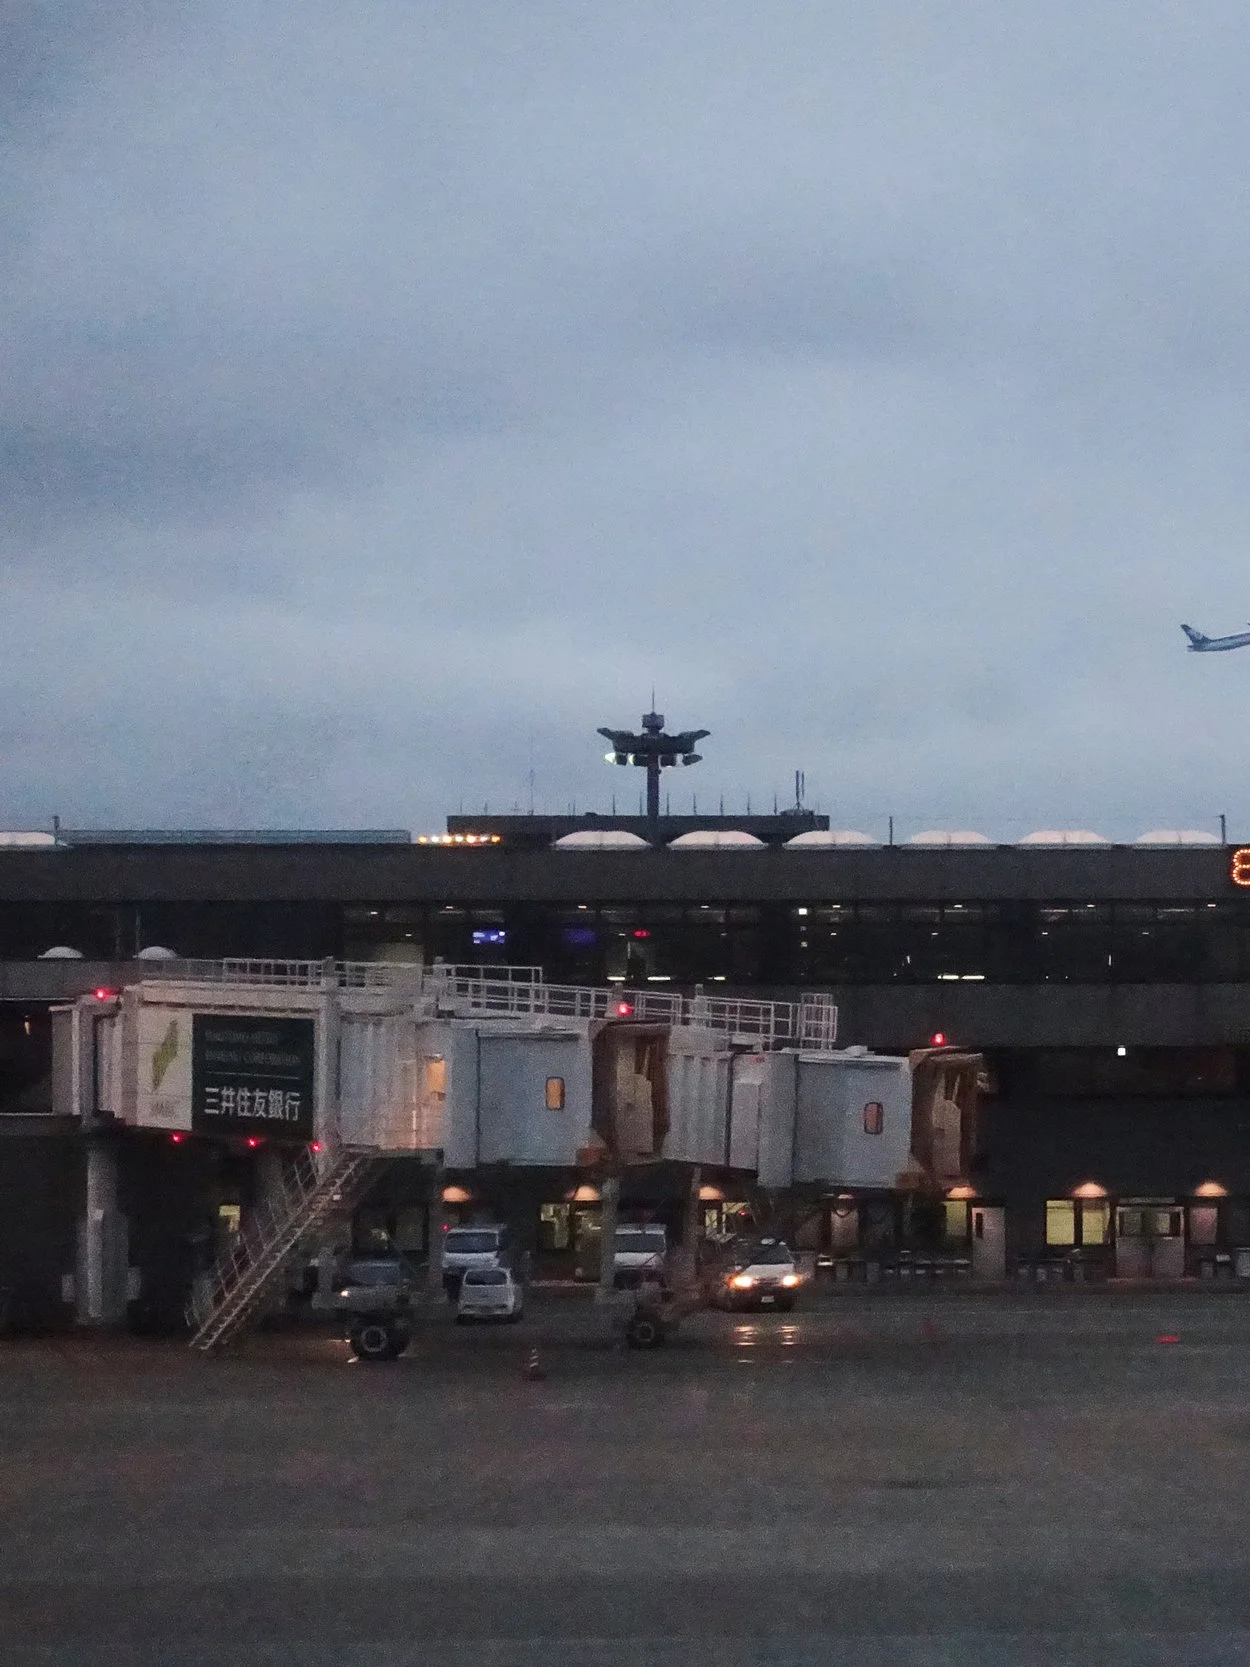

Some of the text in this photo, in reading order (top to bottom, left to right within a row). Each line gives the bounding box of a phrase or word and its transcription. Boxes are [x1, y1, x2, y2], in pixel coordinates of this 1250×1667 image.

[204, 1086, 301, 1121] 三井住友銀行
